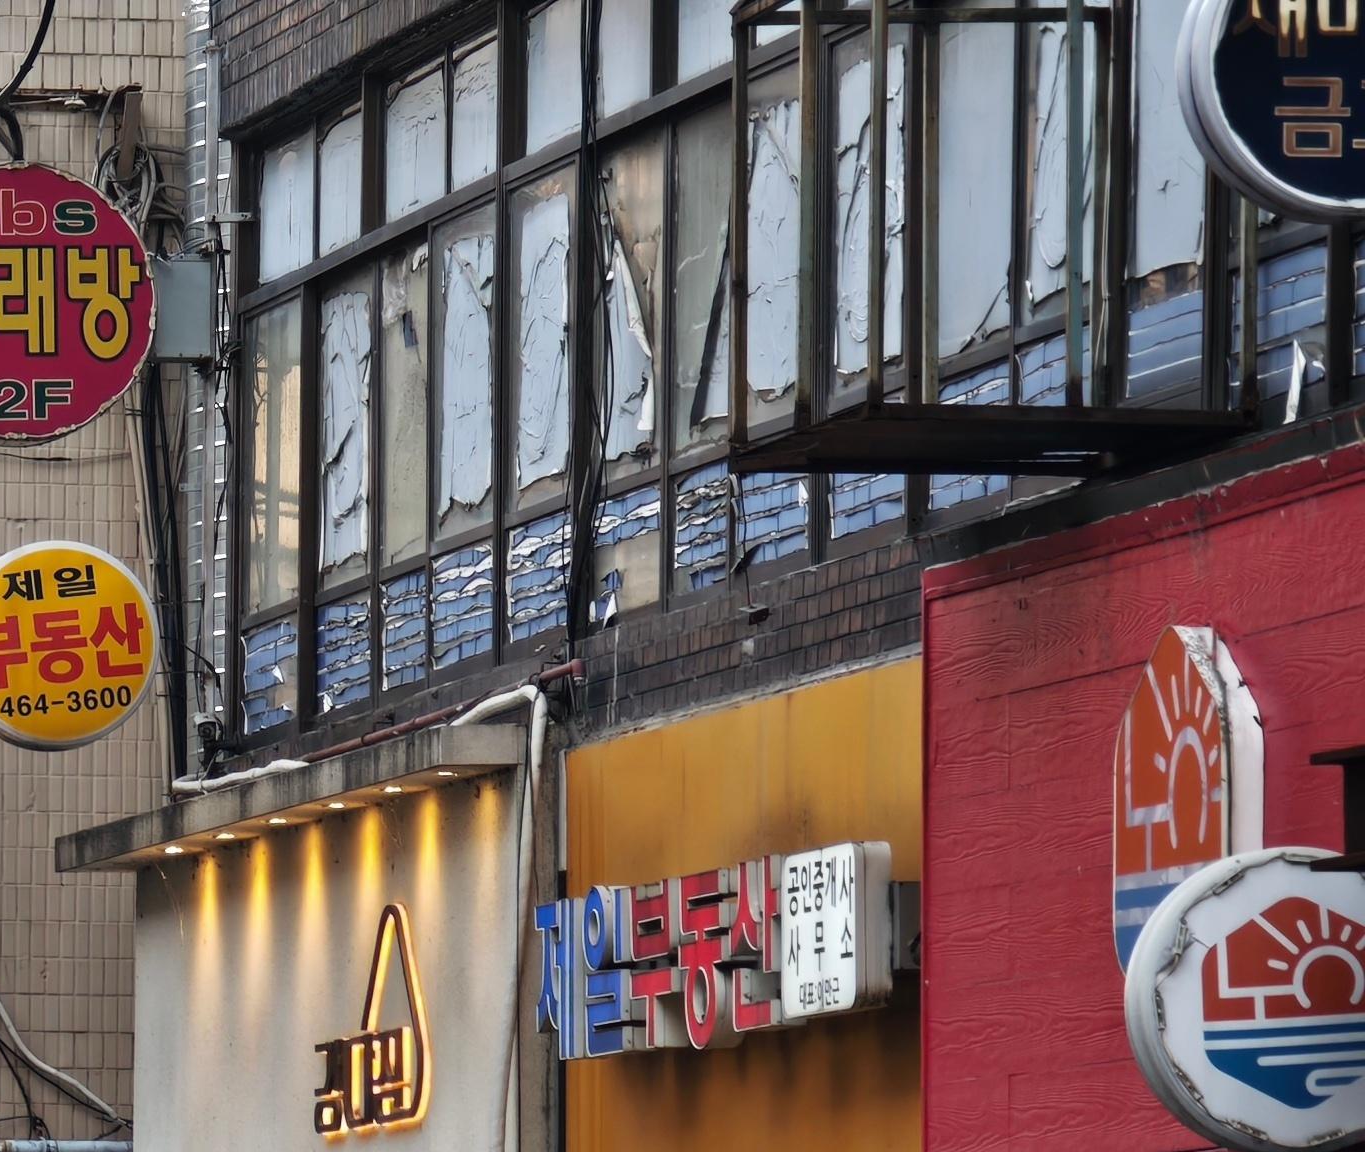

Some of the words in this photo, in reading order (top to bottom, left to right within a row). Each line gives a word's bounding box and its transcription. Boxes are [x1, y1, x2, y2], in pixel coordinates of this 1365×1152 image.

[3, 565, 97, 601] 제일
[0, 686, 132, 718] 464-3600
[787, 854, 855, 917] 공인중개사
